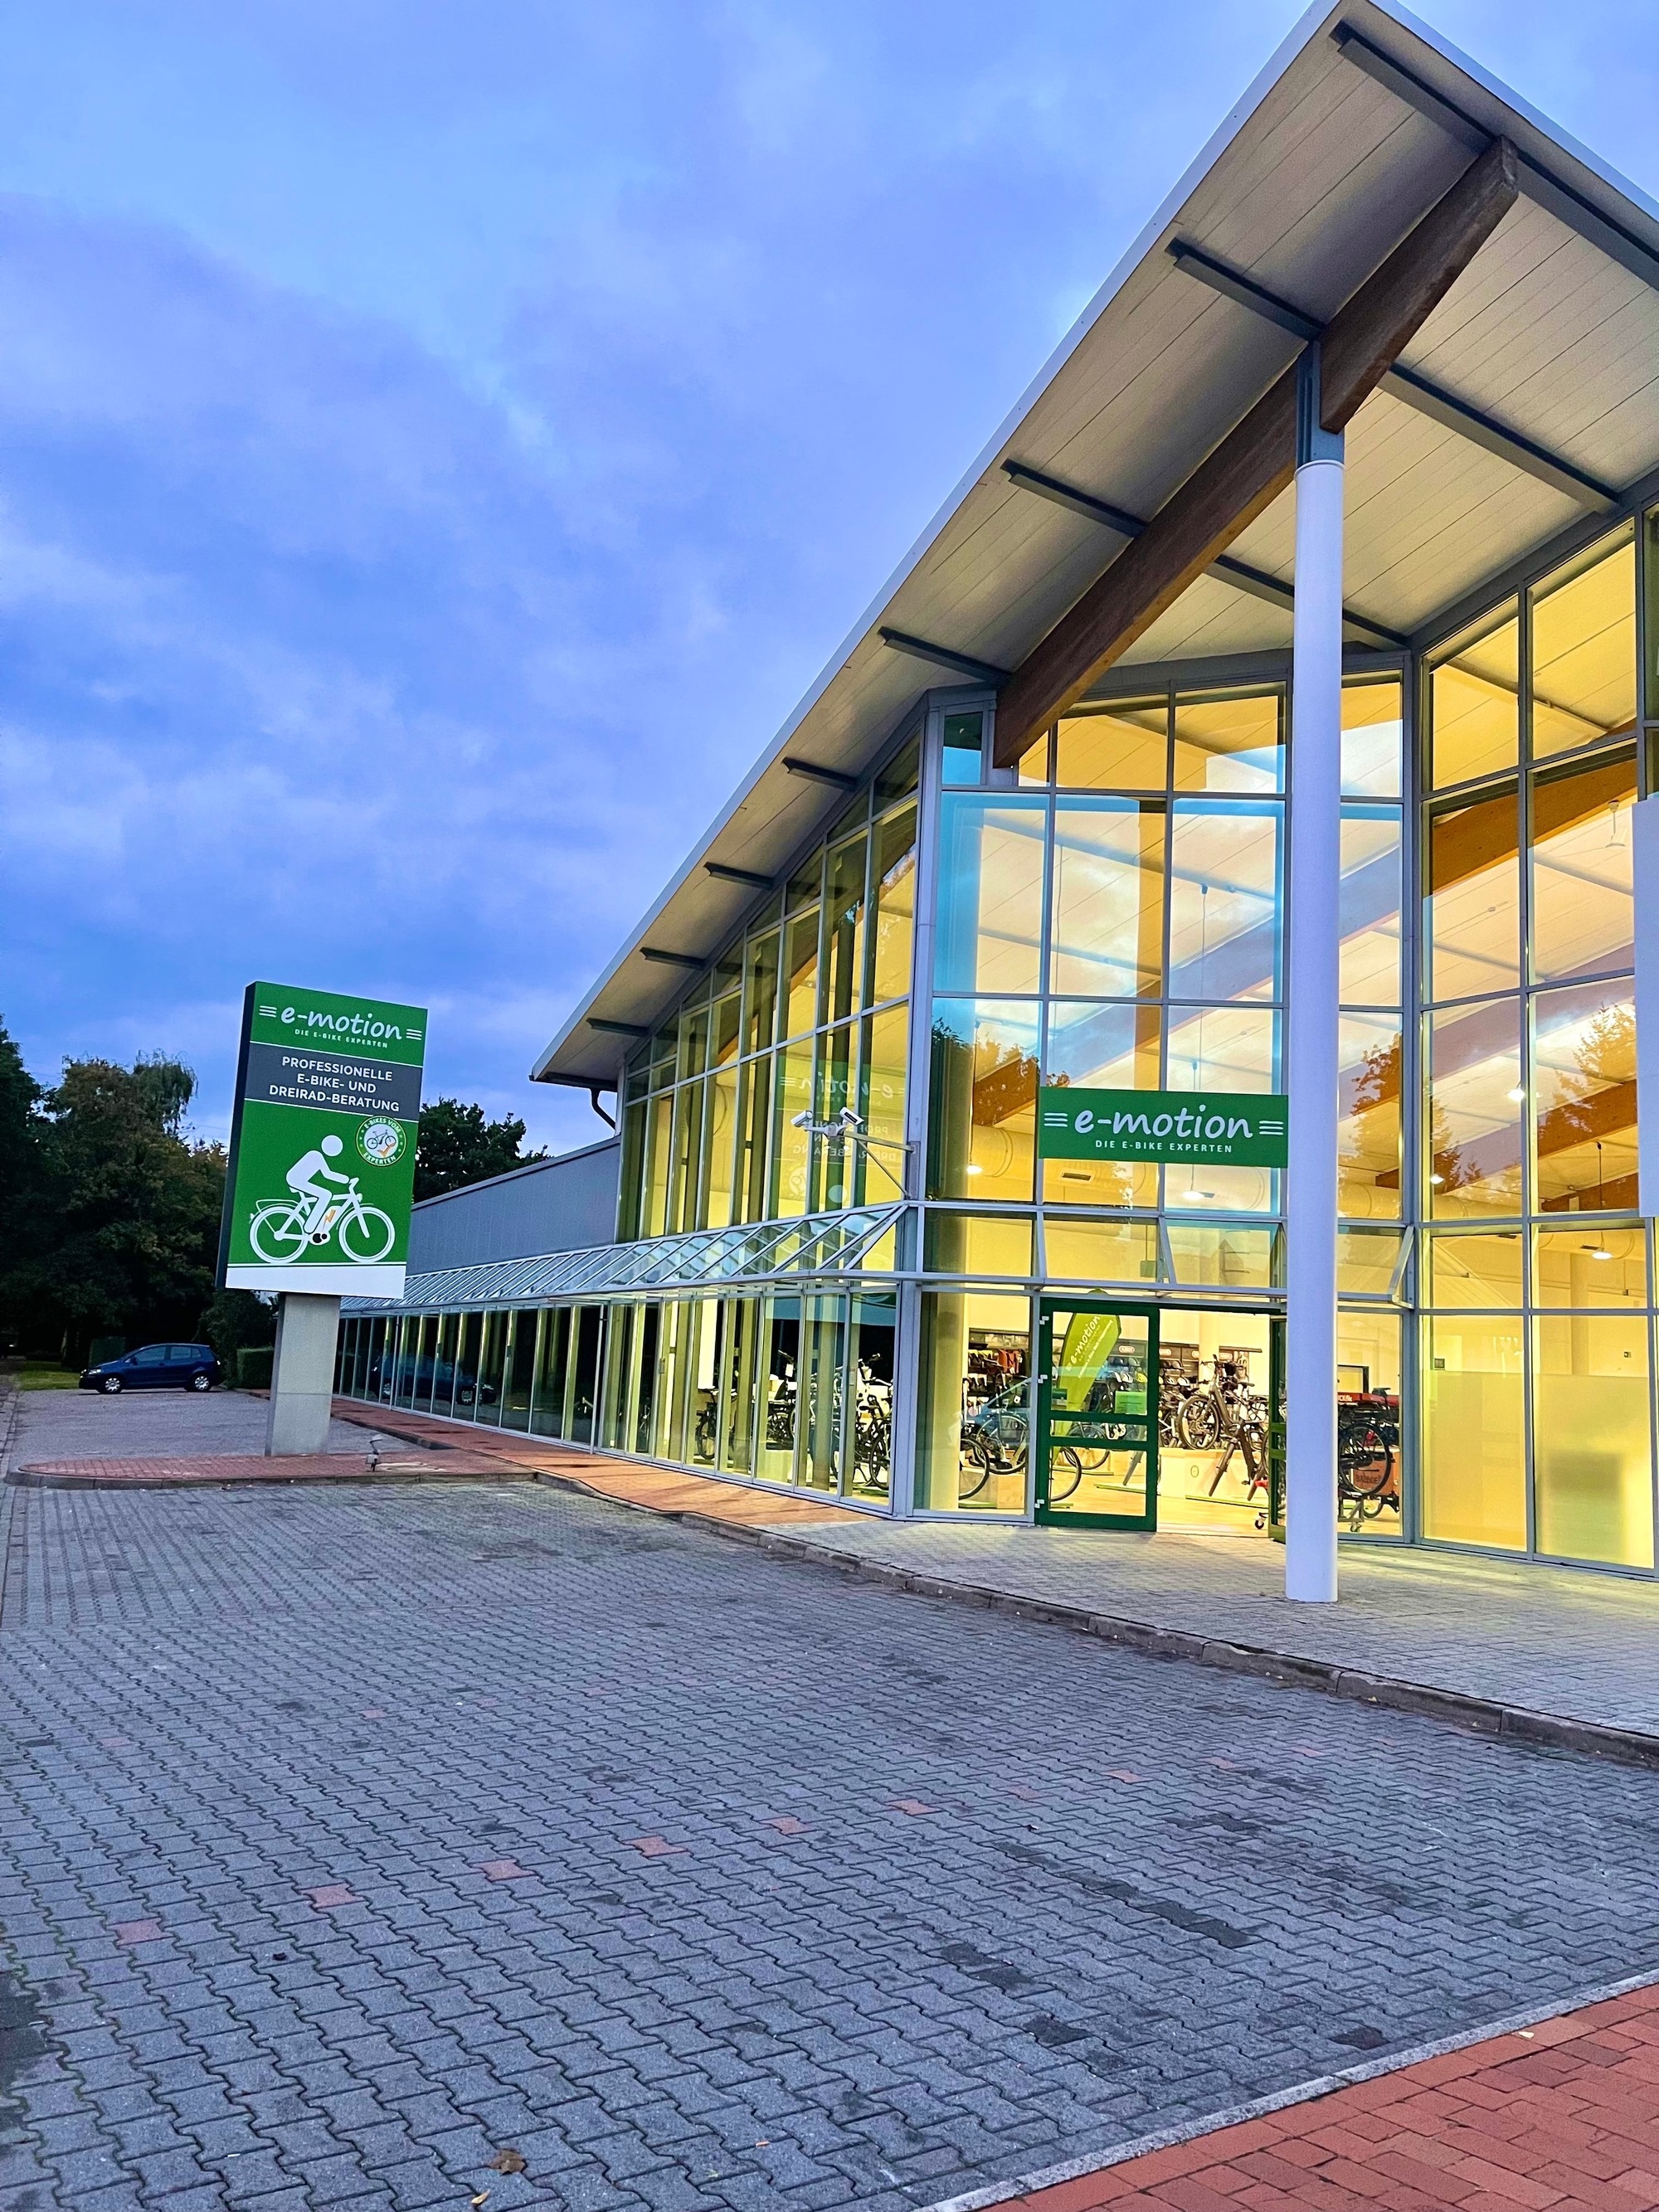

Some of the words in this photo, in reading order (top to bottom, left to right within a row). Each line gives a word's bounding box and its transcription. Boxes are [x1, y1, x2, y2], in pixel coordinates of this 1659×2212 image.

[280, 1006, 402, 1040] e-motion
[294, 1028, 309, 1037] DIE
[313, 1031, 342, 1042] E-BIKE
[345, 1036, 388, 1048] EXPERTEN
[282, 1056, 393, 1082] PROFESSIONELLE
[297, 1073, 345, 1089] E-BIKE-
[348, 1080, 377, 1093] UND
[269, 1084, 400, 1112] DREIRAD-BERATUNG
[364, 1117, 387, 1129] E-BIKES
[387, 1120, 401, 1133] VOM
[1074, 1104, 1253, 1139] e-motion
[363, 1152, 397, 1164] EXPERTEN
[1095, 1140, 1116, 1149] DIE
[1122, 1140, 1163, 1151] E-BIKE
[1169, 1142, 1233, 1153] EXPERTEN
[1070, 1315, 1101, 1364] e-motion
